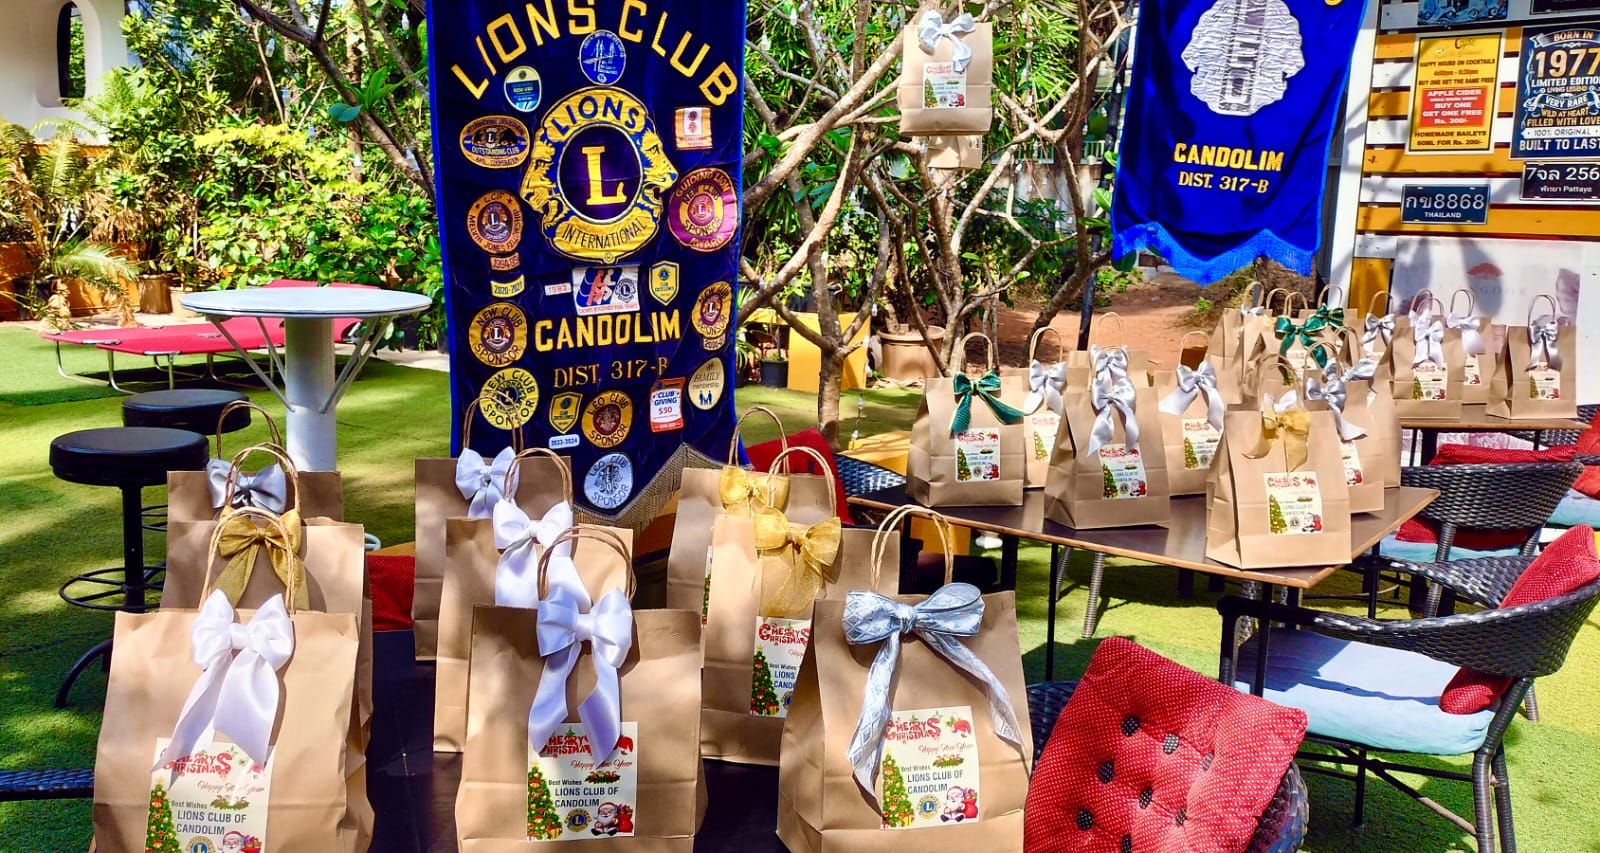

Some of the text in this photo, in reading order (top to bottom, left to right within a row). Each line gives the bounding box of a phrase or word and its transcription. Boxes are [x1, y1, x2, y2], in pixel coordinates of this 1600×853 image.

[1553, 31, 1594, 42] BORN IN
[451, 0, 738, 106] LIONS CLUB
[1535, 47, 1600, 78] 1977
[1531, 76, 1600, 87] LIMITED EDITIO
[1546, 95, 1588, 107] VERY RARE
[551, 96, 639, 136] LIONS
[1541, 108, 1557, 117] WILD
[1568, 107, 1590, 116] HEART
[1527, 118, 1553, 126] FILLED
[1556, 117, 1577, 125] WITH
[1554, 128, 1591, 136] ORIGINAL
[1519, 139, 1552, 151] BUILT
[1555, 139, 1570, 150] TO
[1174, 142, 1284, 172] CANDOLIM
[581, 146, 627, 205] L
[1178, 171, 1269, 193] DIST. 317-B
[562, 218, 647, 249] INTERNATIONAL
[476, 306, 522, 327] NEW CLUB
[535, 309, 680, 352] CANDOLIM
[475, 343, 520, 365] SPONSOR
[512, 370, 535, 394] CLUB
[587, 393, 628, 415] LEO CLUB
[654, 397, 677, 406] GIVING
[589, 424, 626, 446] SPONSOR
[590, 455, 628, 476] LEO CLUB
[592, 484, 629, 506] SPONSOR
[774, 671, 795, 680] LIONS
[774, 680, 795, 689] CAND
[907, 769, 963, 783] LIONS CLUB OF
[555, 786, 619, 796] LIONS CLUB OF
[907, 783, 948, 794] CANDOLIM
[186, 801, 207, 809] Wishes
[555, 799, 600, 808] CANDOLIM
[177, 810, 247, 823] LIONS CLUB OF
[176, 823, 225, 835] CANDOLIM
